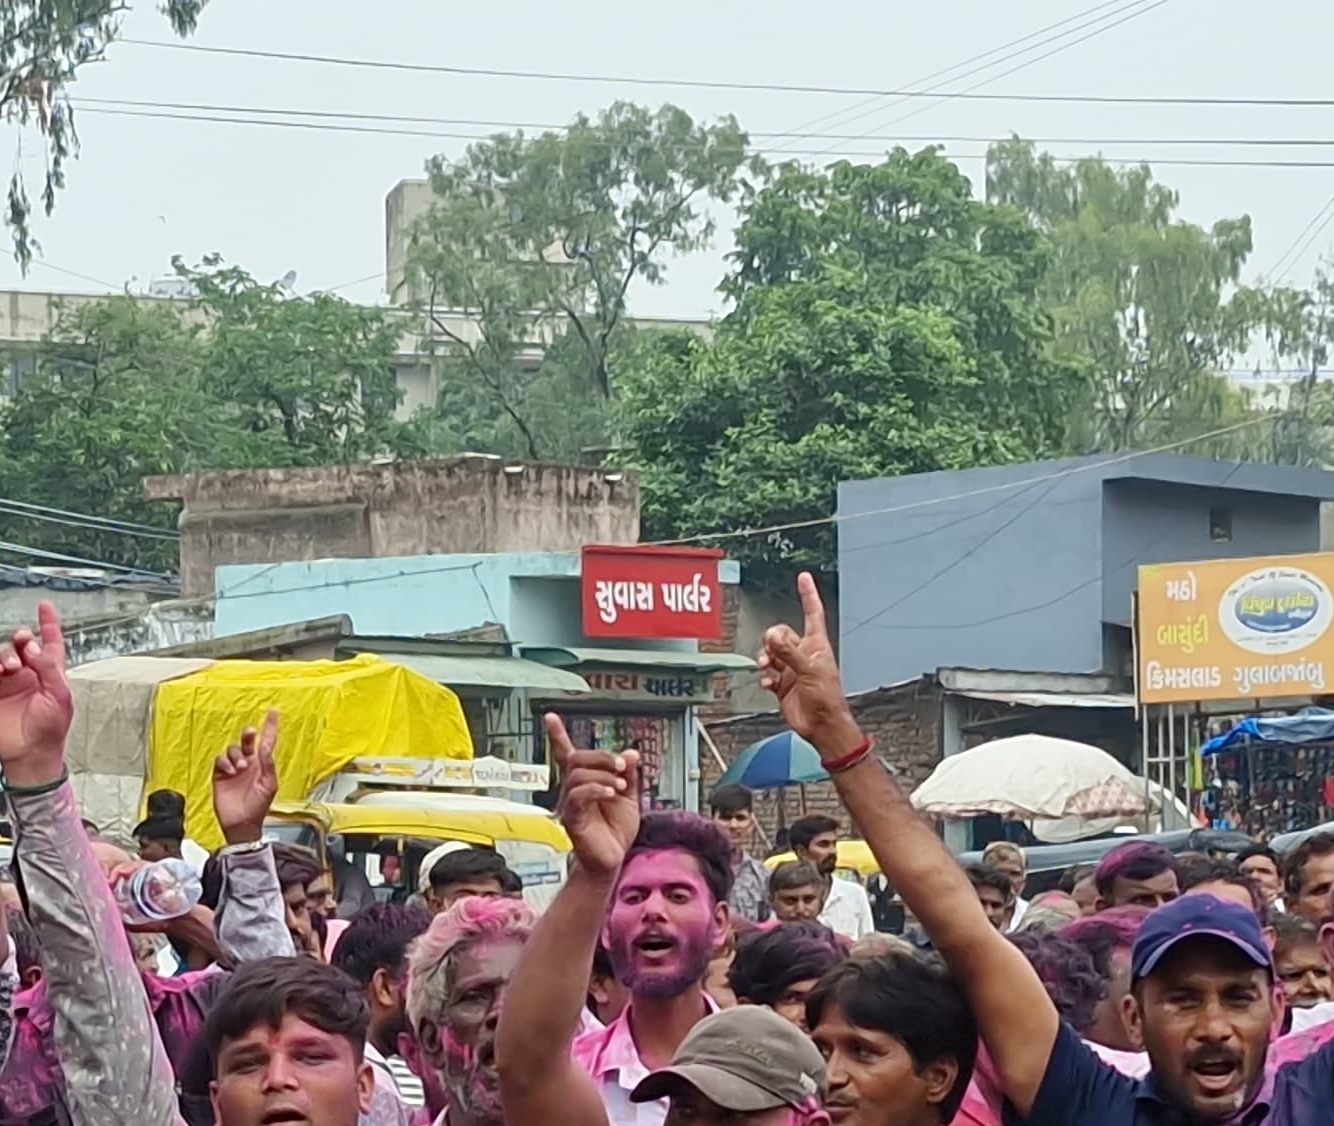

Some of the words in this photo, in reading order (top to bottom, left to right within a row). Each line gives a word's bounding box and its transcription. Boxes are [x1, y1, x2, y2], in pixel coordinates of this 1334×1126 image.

[594, 580, 655, 624] સુવાસ
[661, 572, 712, 613] પાર્લર
[1166, 570, 1197, 601] મઠો
[1156, 613, 1209, 654] બાસુંદી
